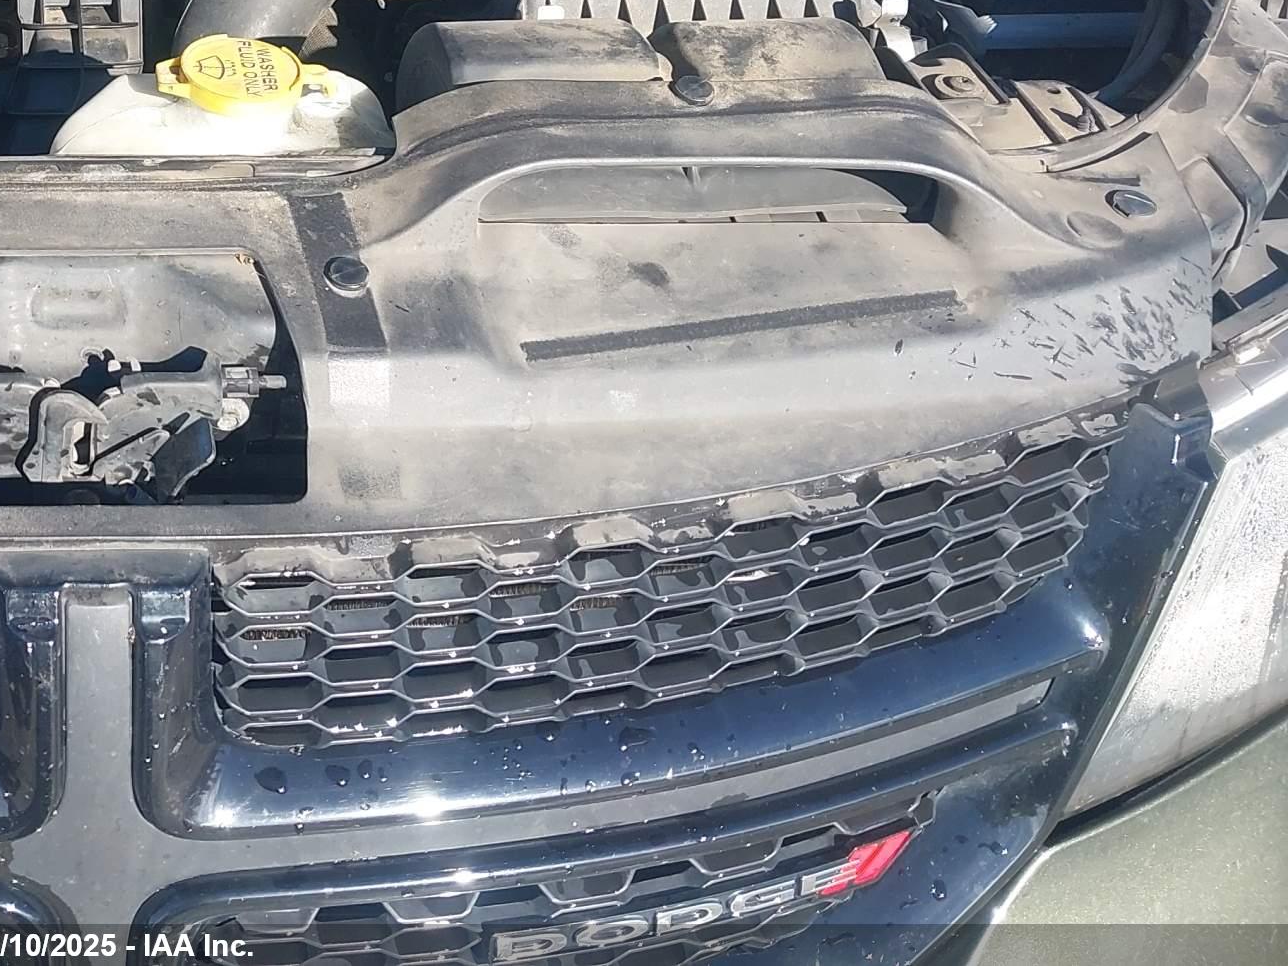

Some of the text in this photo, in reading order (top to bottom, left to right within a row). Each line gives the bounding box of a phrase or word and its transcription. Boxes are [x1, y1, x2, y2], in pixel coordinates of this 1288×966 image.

[238, 40, 263, 97] FLUID ONLY
[256, 48, 279, 92] WASHER
[492, 858, 860, 962] DODGE
